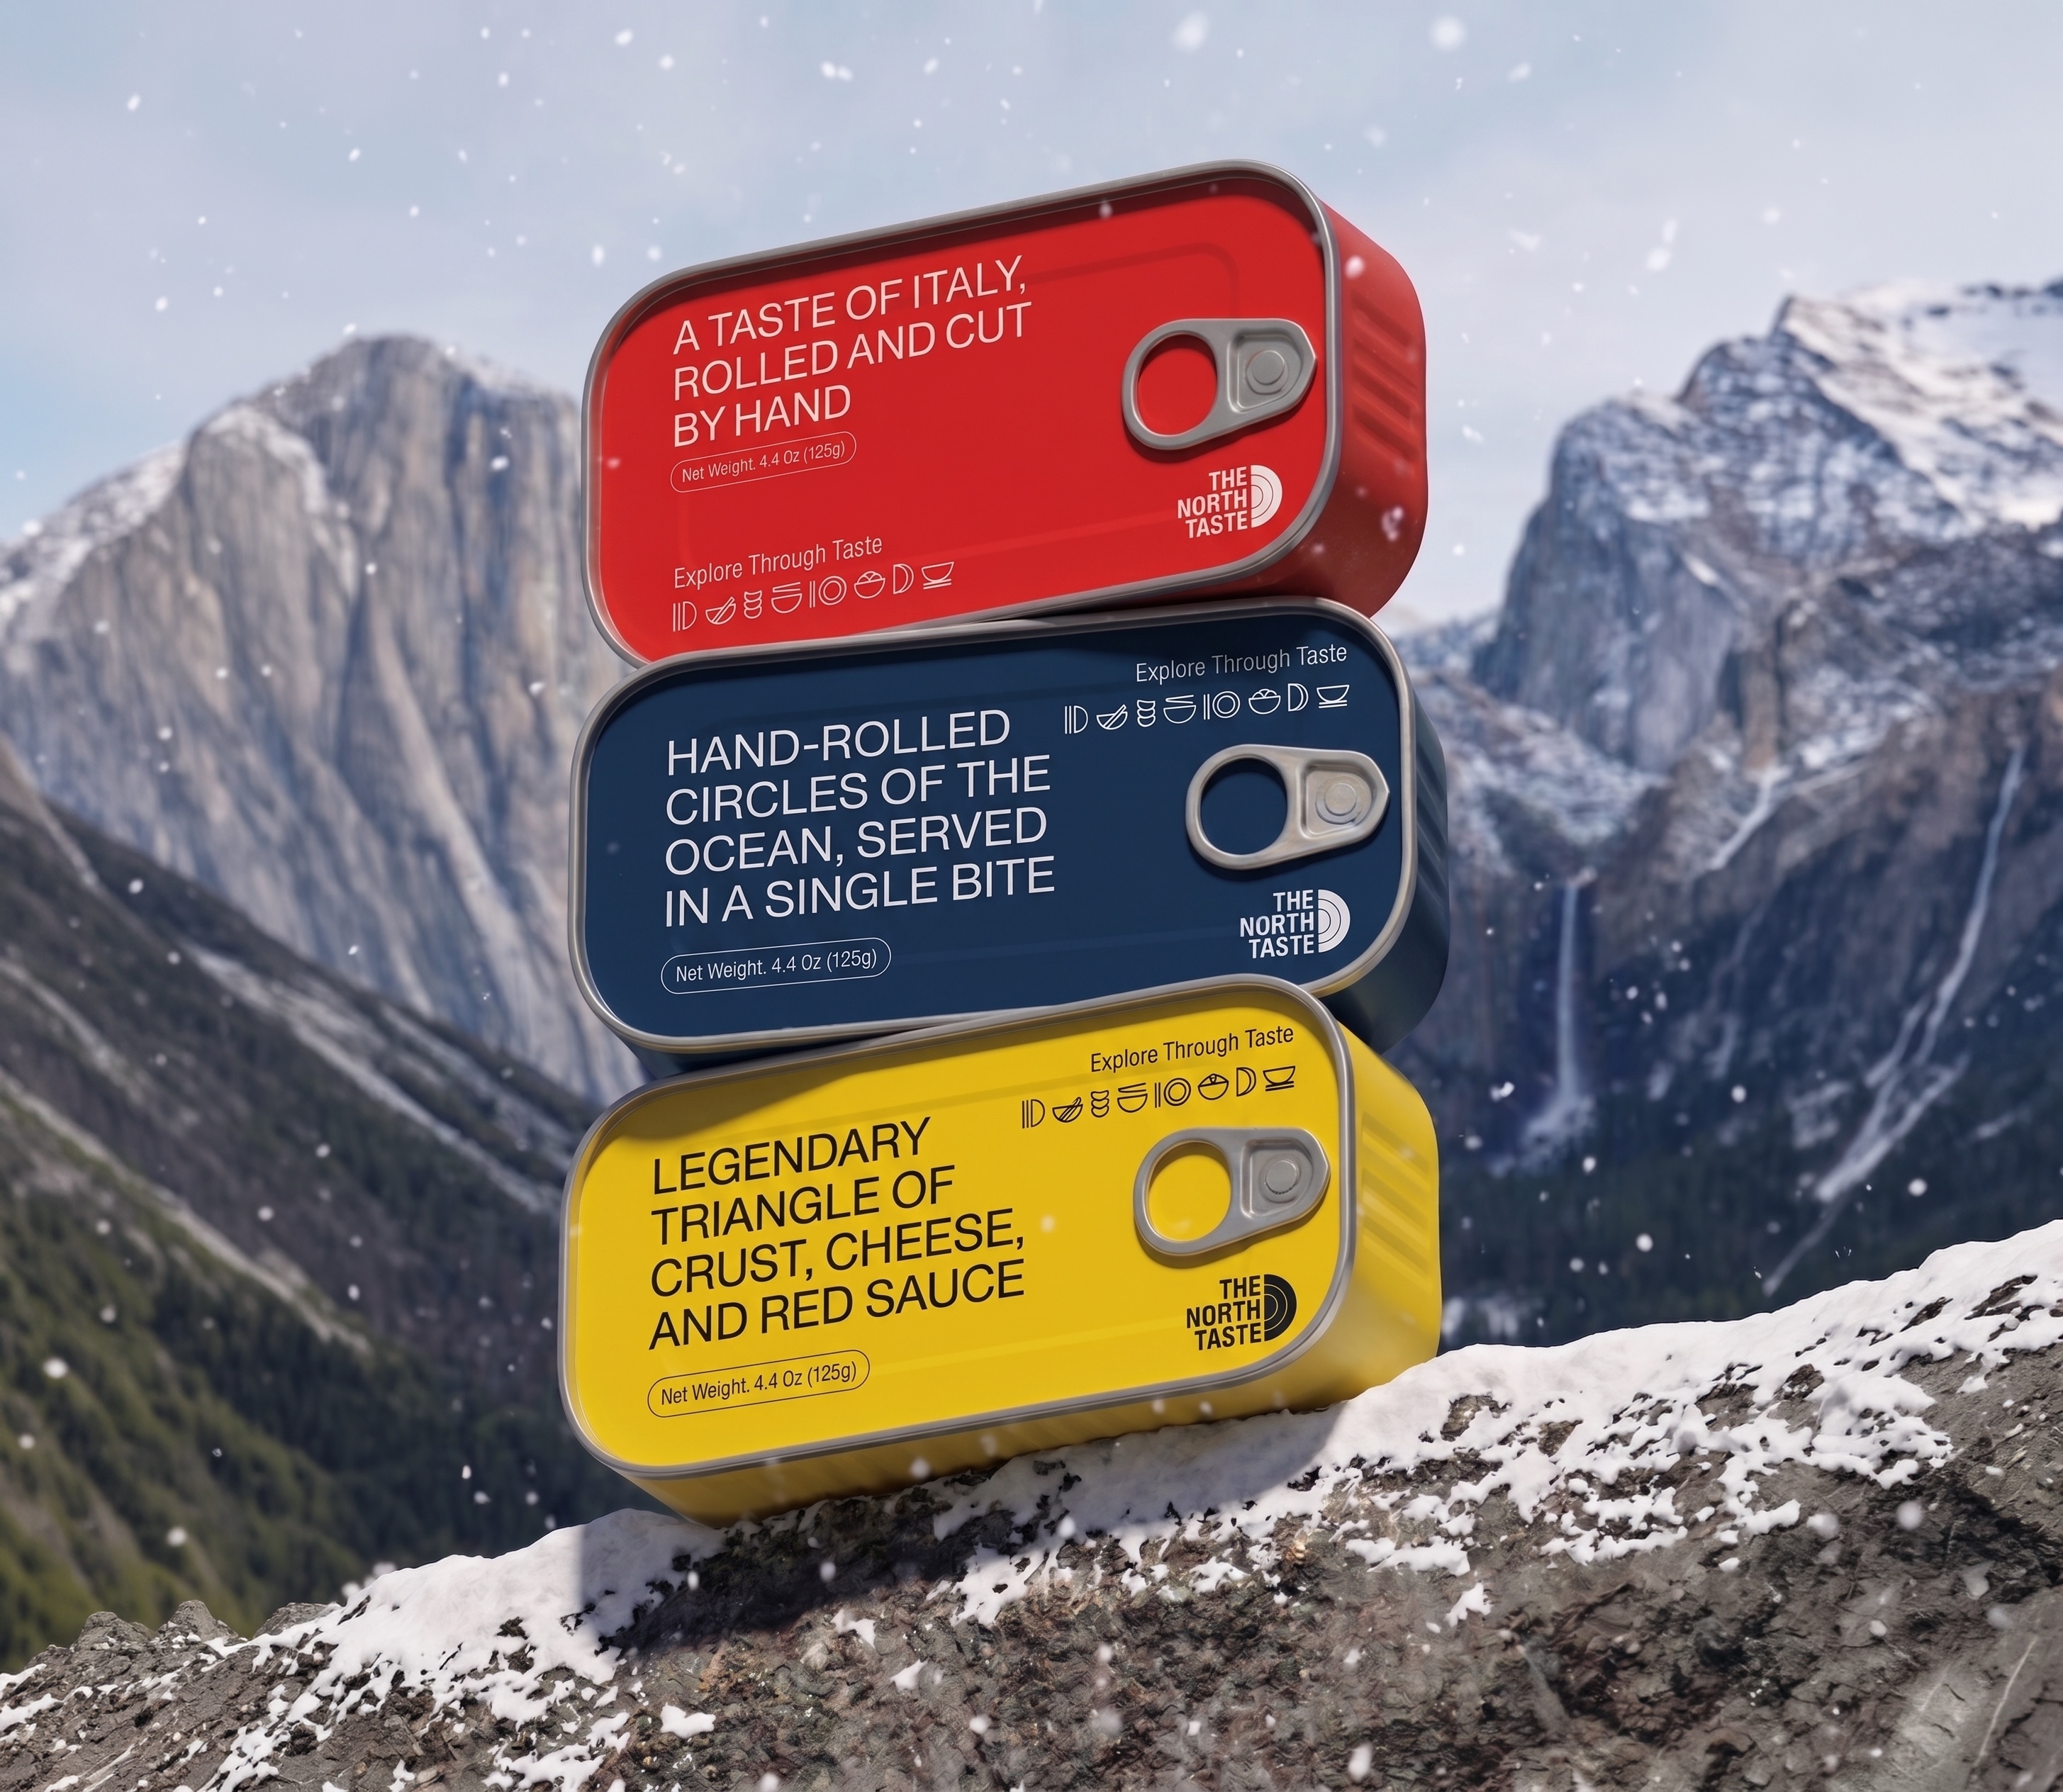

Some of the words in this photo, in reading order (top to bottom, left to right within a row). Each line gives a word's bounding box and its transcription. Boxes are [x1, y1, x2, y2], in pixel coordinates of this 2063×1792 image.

[673, 320, 700, 355] A
[708, 291, 836, 347] TASTE
[846, 278, 902, 320] OF
[914, 254, 1025, 309] ITALY,
[674, 340, 838, 401] ROLLED
[846, 322, 936, 369] AND
[946, 301, 1032, 349] CUT
[674, 405, 726, 447] BY
[735, 384, 851, 437] HAND
[682, 466, 705, 483] Net
[708, 457, 756, 478] Weight.
[759, 452, 780, 468] 4.4
[783, 449, 800, 464] Oz
[803, 440, 845, 464] (125g)
[1208, 466, 1248, 491] THE
[1178, 488, 1247, 519] NORTH
[1185, 510, 1248, 539] TASTE
[674, 562, 743, 590] Explore
[748, 543, 826, 576] Through
[832, 536, 883, 561] Taste
[1136, 660, 1205, 685] Explore
[1211, 649, 1290, 674] Through
[1296, 644, 1347, 666] Taste
[668, 709, 1010, 776] HAND-ROLLED
[666, 772, 868, 825] CIRCLES
[881, 764, 946, 805] OF
[956, 754, 1051, 797] THE
[665, 825, 843, 875] OCEAN,
[857, 807, 1047, 858] SERVED
[666, 887, 708, 927] IN
[721, 885, 754, 922] A
[765, 866, 938, 918] SINGLE
[953, 855, 1055, 901] BITE
[1273, 889, 1314, 912] THE
[1240, 911, 1314, 937] NORTH
[1248, 934, 1314, 959] TASTE
[676, 965, 703, 982] Net
[708, 960, 766, 981] Weight.
[771, 956, 797, 973] 4.4
[801, 954, 822, 970] Oz
[827, 948, 877, 973] (125g)
[1091, 1048, 1158, 1074] Explore
[1163, 1032, 1239, 1061] Through
[1244, 1026, 1294, 1048] Taste
[654, 1116, 931, 1195] LEGENDARY
[651, 1176, 880, 1245] TRIANGLE
[892, 1164, 955, 1209] OF
[651, 1238, 813, 1297] CRUST,
[826, 1207, 1024, 1271] CHEESE,
[648, 1301, 747, 1350] AND
[761, 1285, 853, 1334] RED
[866, 1258, 1024, 1318] SAUCE
[1219, 1275, 1261, 1300] THE
[1186, 1298, 1260, 1329] NORTH
[1194, 1322, 1262, 1351] TASTE
[661, 1387, 688, 1406] Net
[691, 1377, 750, 1401] Weight.
[754, 1372, 778, 1391] 4.4
[783, 1370, 803, 1387] Oz
[807, 1360, 856, 1388] (125g)
